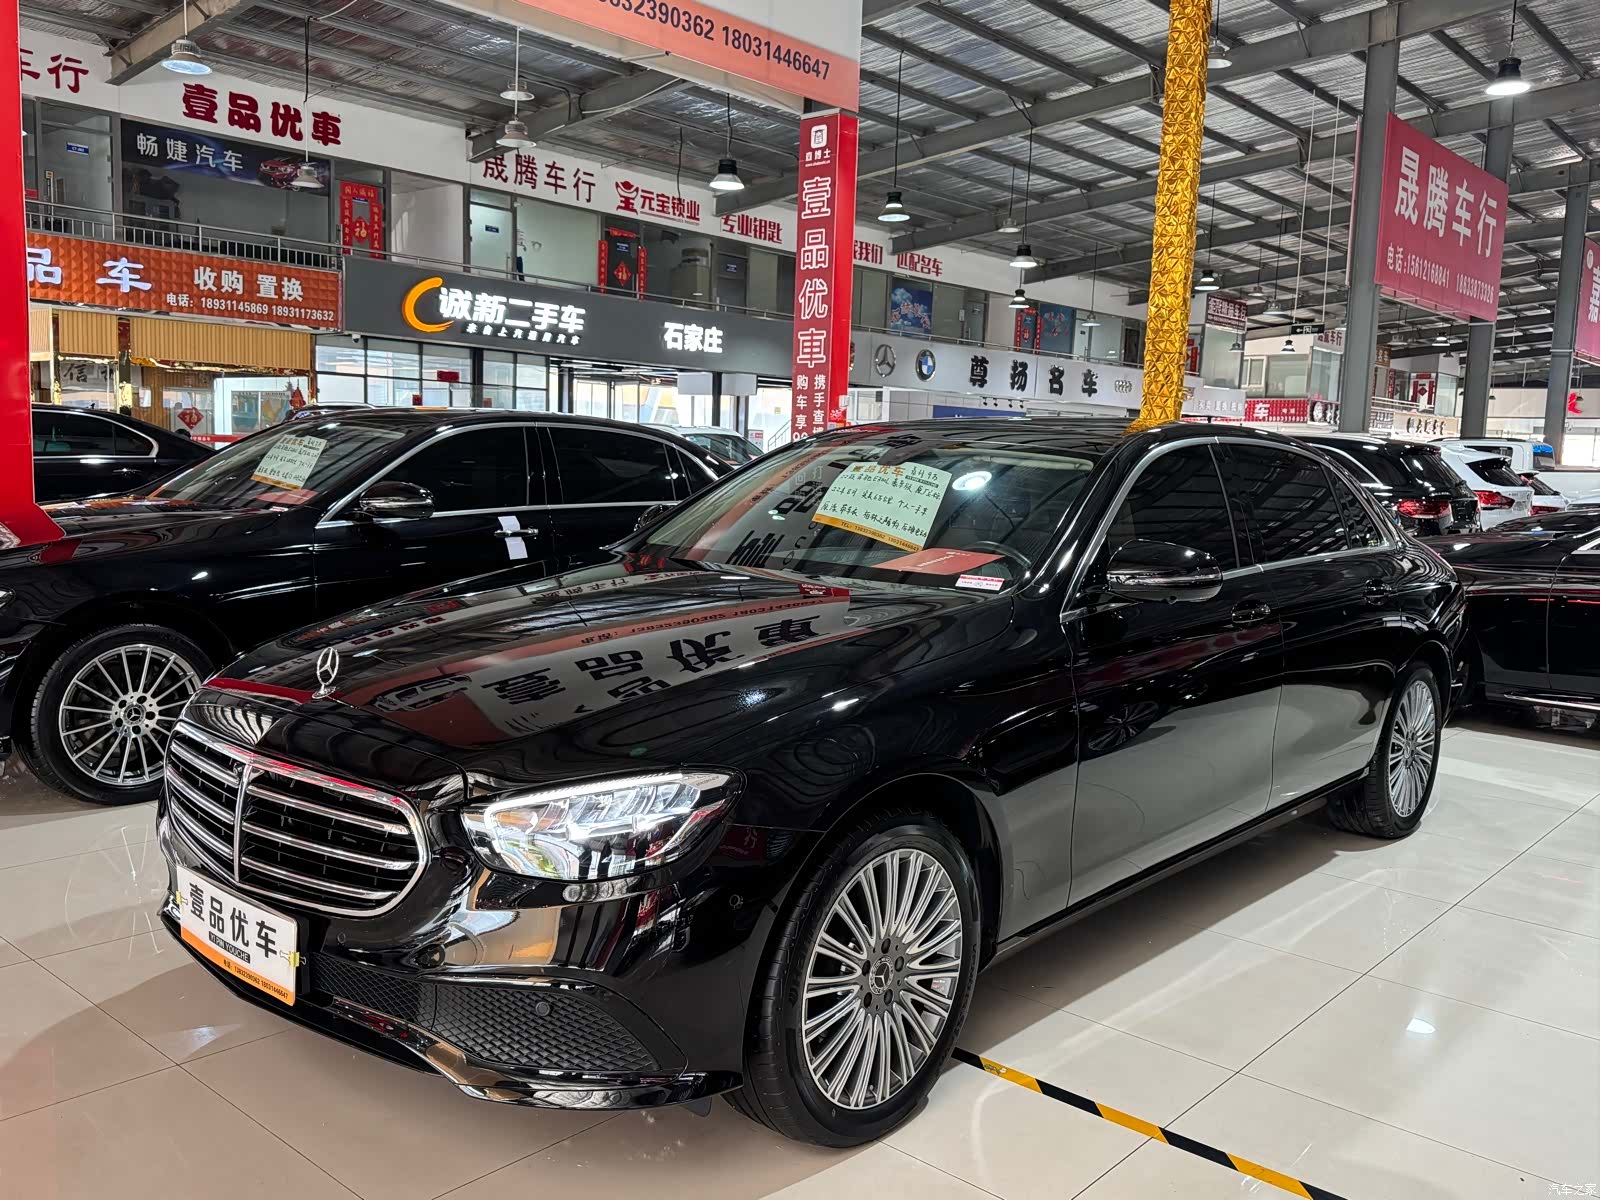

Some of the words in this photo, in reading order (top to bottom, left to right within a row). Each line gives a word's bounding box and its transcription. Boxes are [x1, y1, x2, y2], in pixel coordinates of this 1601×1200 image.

[722, 26, 830, 80] 18031446647
[640, 189, 700, 221] 元宝锁业
[1394, 146, 1498, 258] 晟腾车行
[721, 213, 783, 245] 专业钥匙
[194, 266, 243, 295] 收购
[257, 275, 304, 302] 置换
[201, 297, 268, 314] 18931145869
[272, 305, 335, 321] 18931173632
[439, 287, 586, 333] 诚新二手车
[663, 322, 723, 353] 石家庄
[969, 355, 1098, 397] 尊扬名车
[189, 882, 277, 958] 壹品优车
